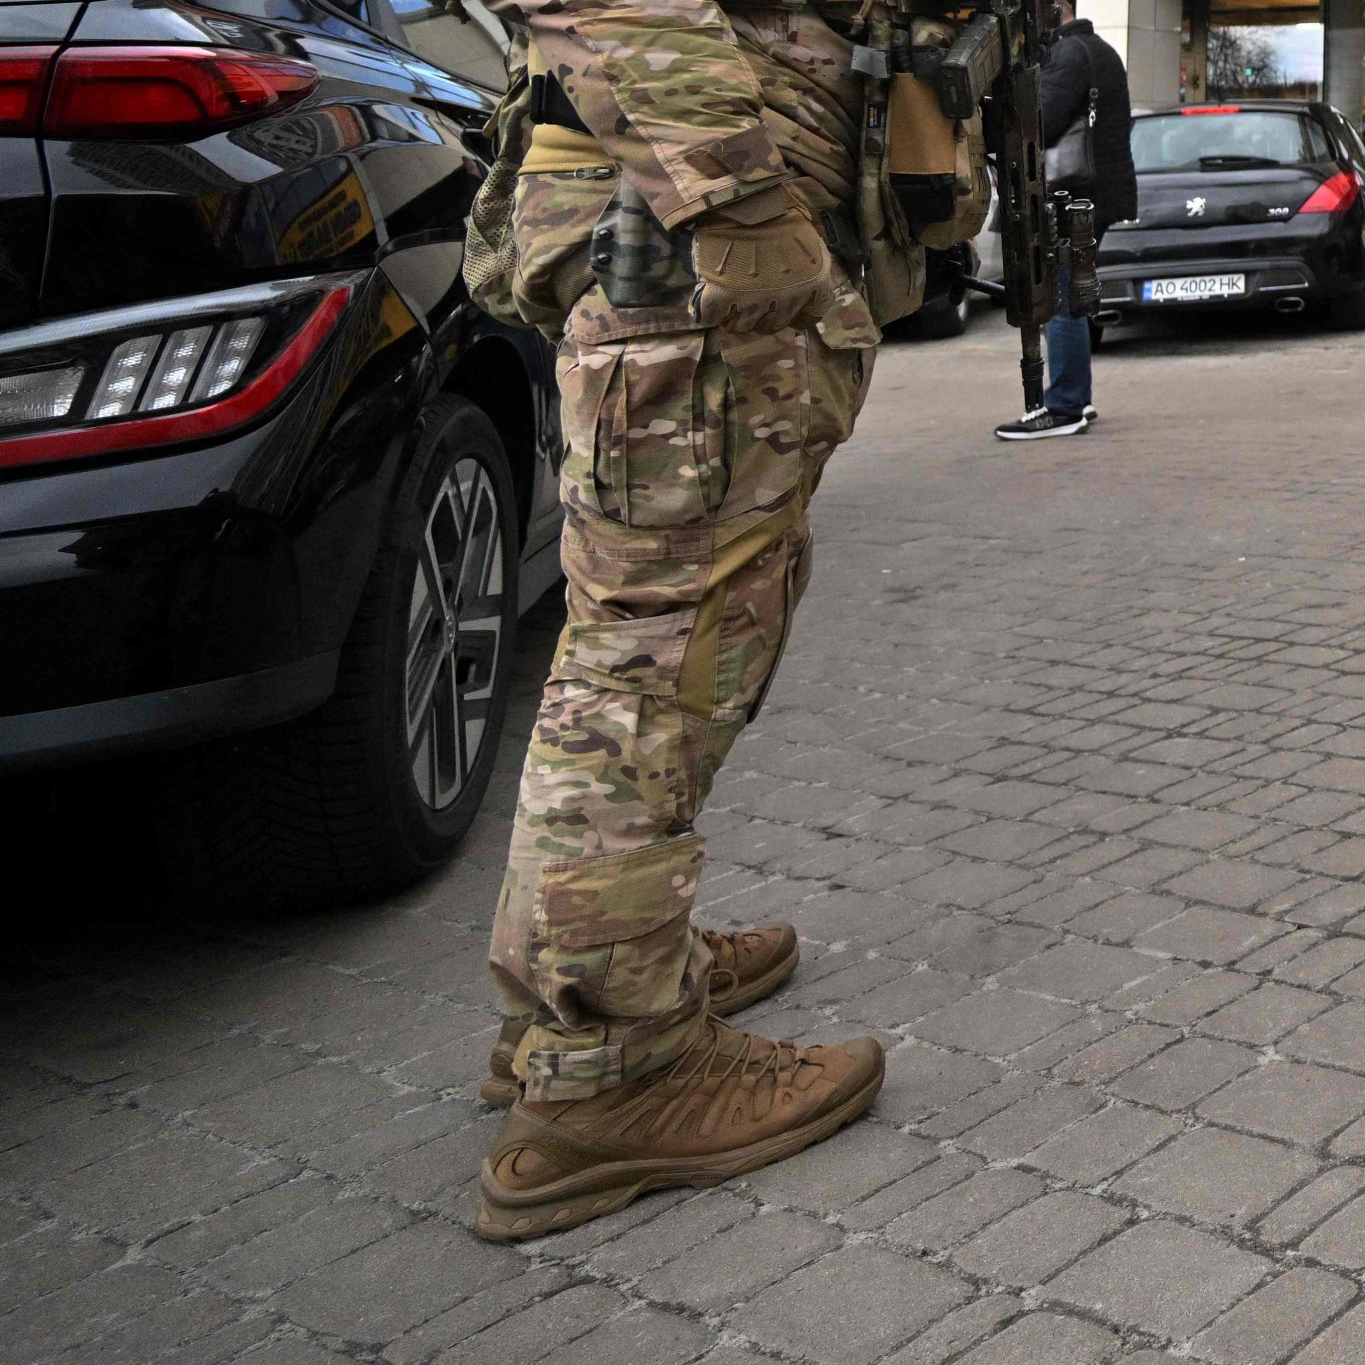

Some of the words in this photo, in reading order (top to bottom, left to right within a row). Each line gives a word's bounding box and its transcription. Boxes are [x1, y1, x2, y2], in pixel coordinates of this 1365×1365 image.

[1267, 207, 1289, 217] 308
[1154, 280, 1176, 296] AO
[1180, 278, 1216, 295] 4002
[1219, 276, 1242, 292] HK
